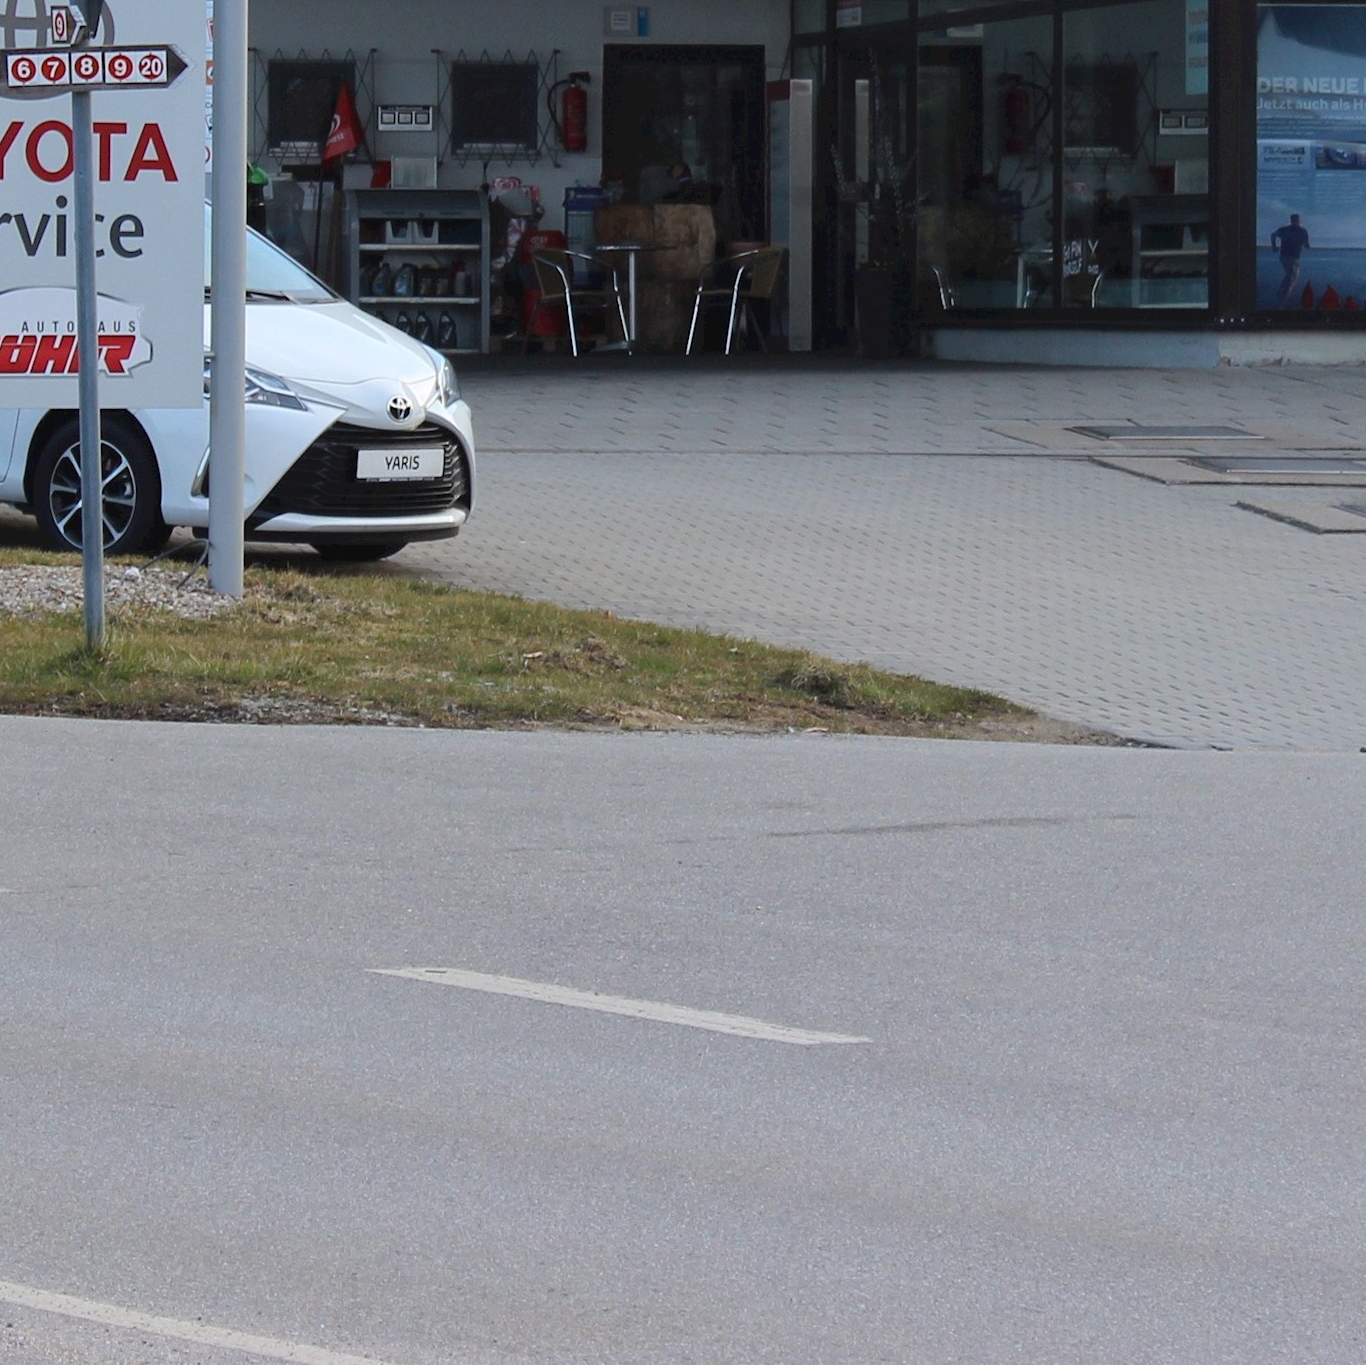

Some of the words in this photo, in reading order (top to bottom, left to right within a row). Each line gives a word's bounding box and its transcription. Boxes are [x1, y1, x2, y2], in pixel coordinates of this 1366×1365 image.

[56, 16, 63, 34] 9
[17, 61, 30, 78] 6
[46, 61, 60, 78] 7
[80, 58, 94, 76] 8
[114, 58, 128, 76] 9
[141, 58, 163, 76] 20
[1256, 76, 1298, 94] DER
[1302, 76, 1358, 95] NEUE
[1256, 98, 1292, 111] Jetzt
[1295, 98, 1328, 111] auch
[1331, 99, 1351, 111] als
[21, 321, 136, 333] AUTOAUS
[385, 455, 420, 471] YARIS
